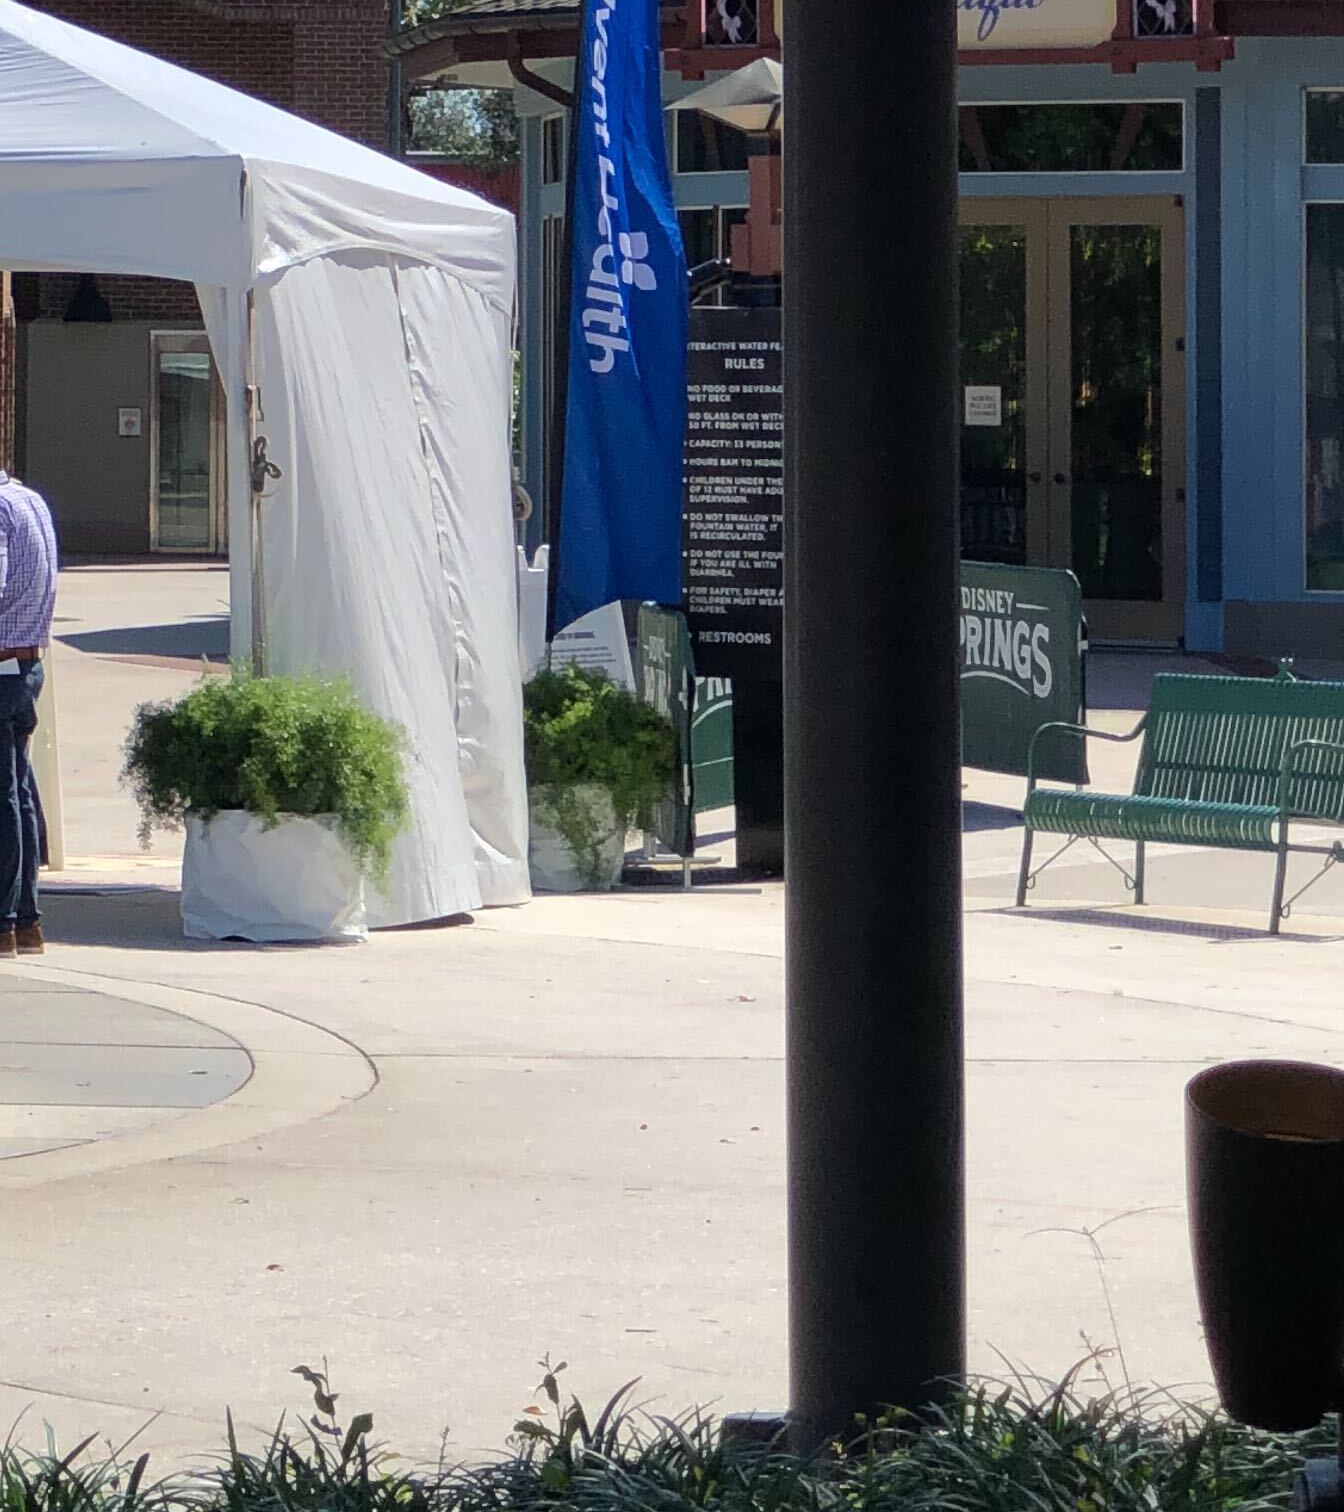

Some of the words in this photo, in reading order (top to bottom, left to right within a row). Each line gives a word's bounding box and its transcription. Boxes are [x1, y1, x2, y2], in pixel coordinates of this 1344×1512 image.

[739, 342, 768, 350] WATER
[725, 358, 765, 369] RULES
[689, 477, 732, 485] CHILDREN
[735, 477, 764, 485] UNDER
[705, 550, 722, 558] NOT
[960, 586, 1015, 615] DISNEY
[698, 631, 772, 645] RESTROOMS
[959, 614, 1053, 699] RINGS
